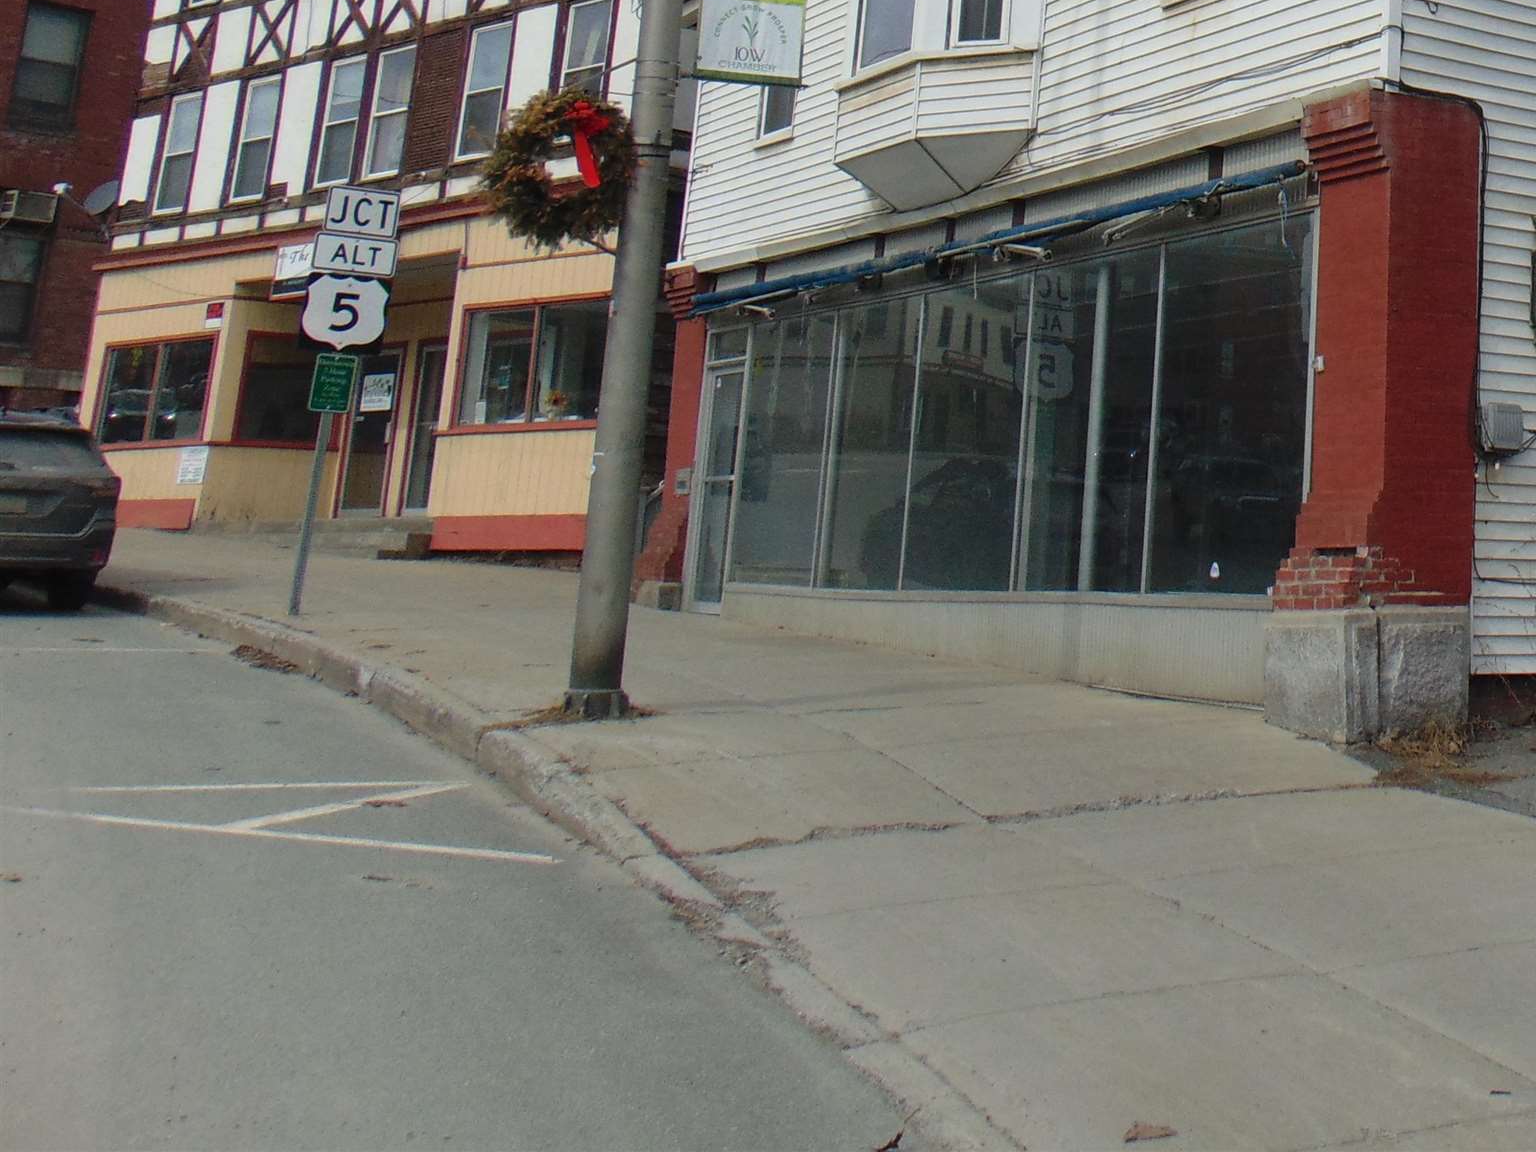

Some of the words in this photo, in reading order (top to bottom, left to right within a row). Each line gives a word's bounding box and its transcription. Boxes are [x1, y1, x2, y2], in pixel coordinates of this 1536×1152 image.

[718, 59, 776, 73] CHAMBER
[330, 195, 395, 230] JCT
[331, 242, 383, 268] ALT
[328, 292, 360, 332] 5
